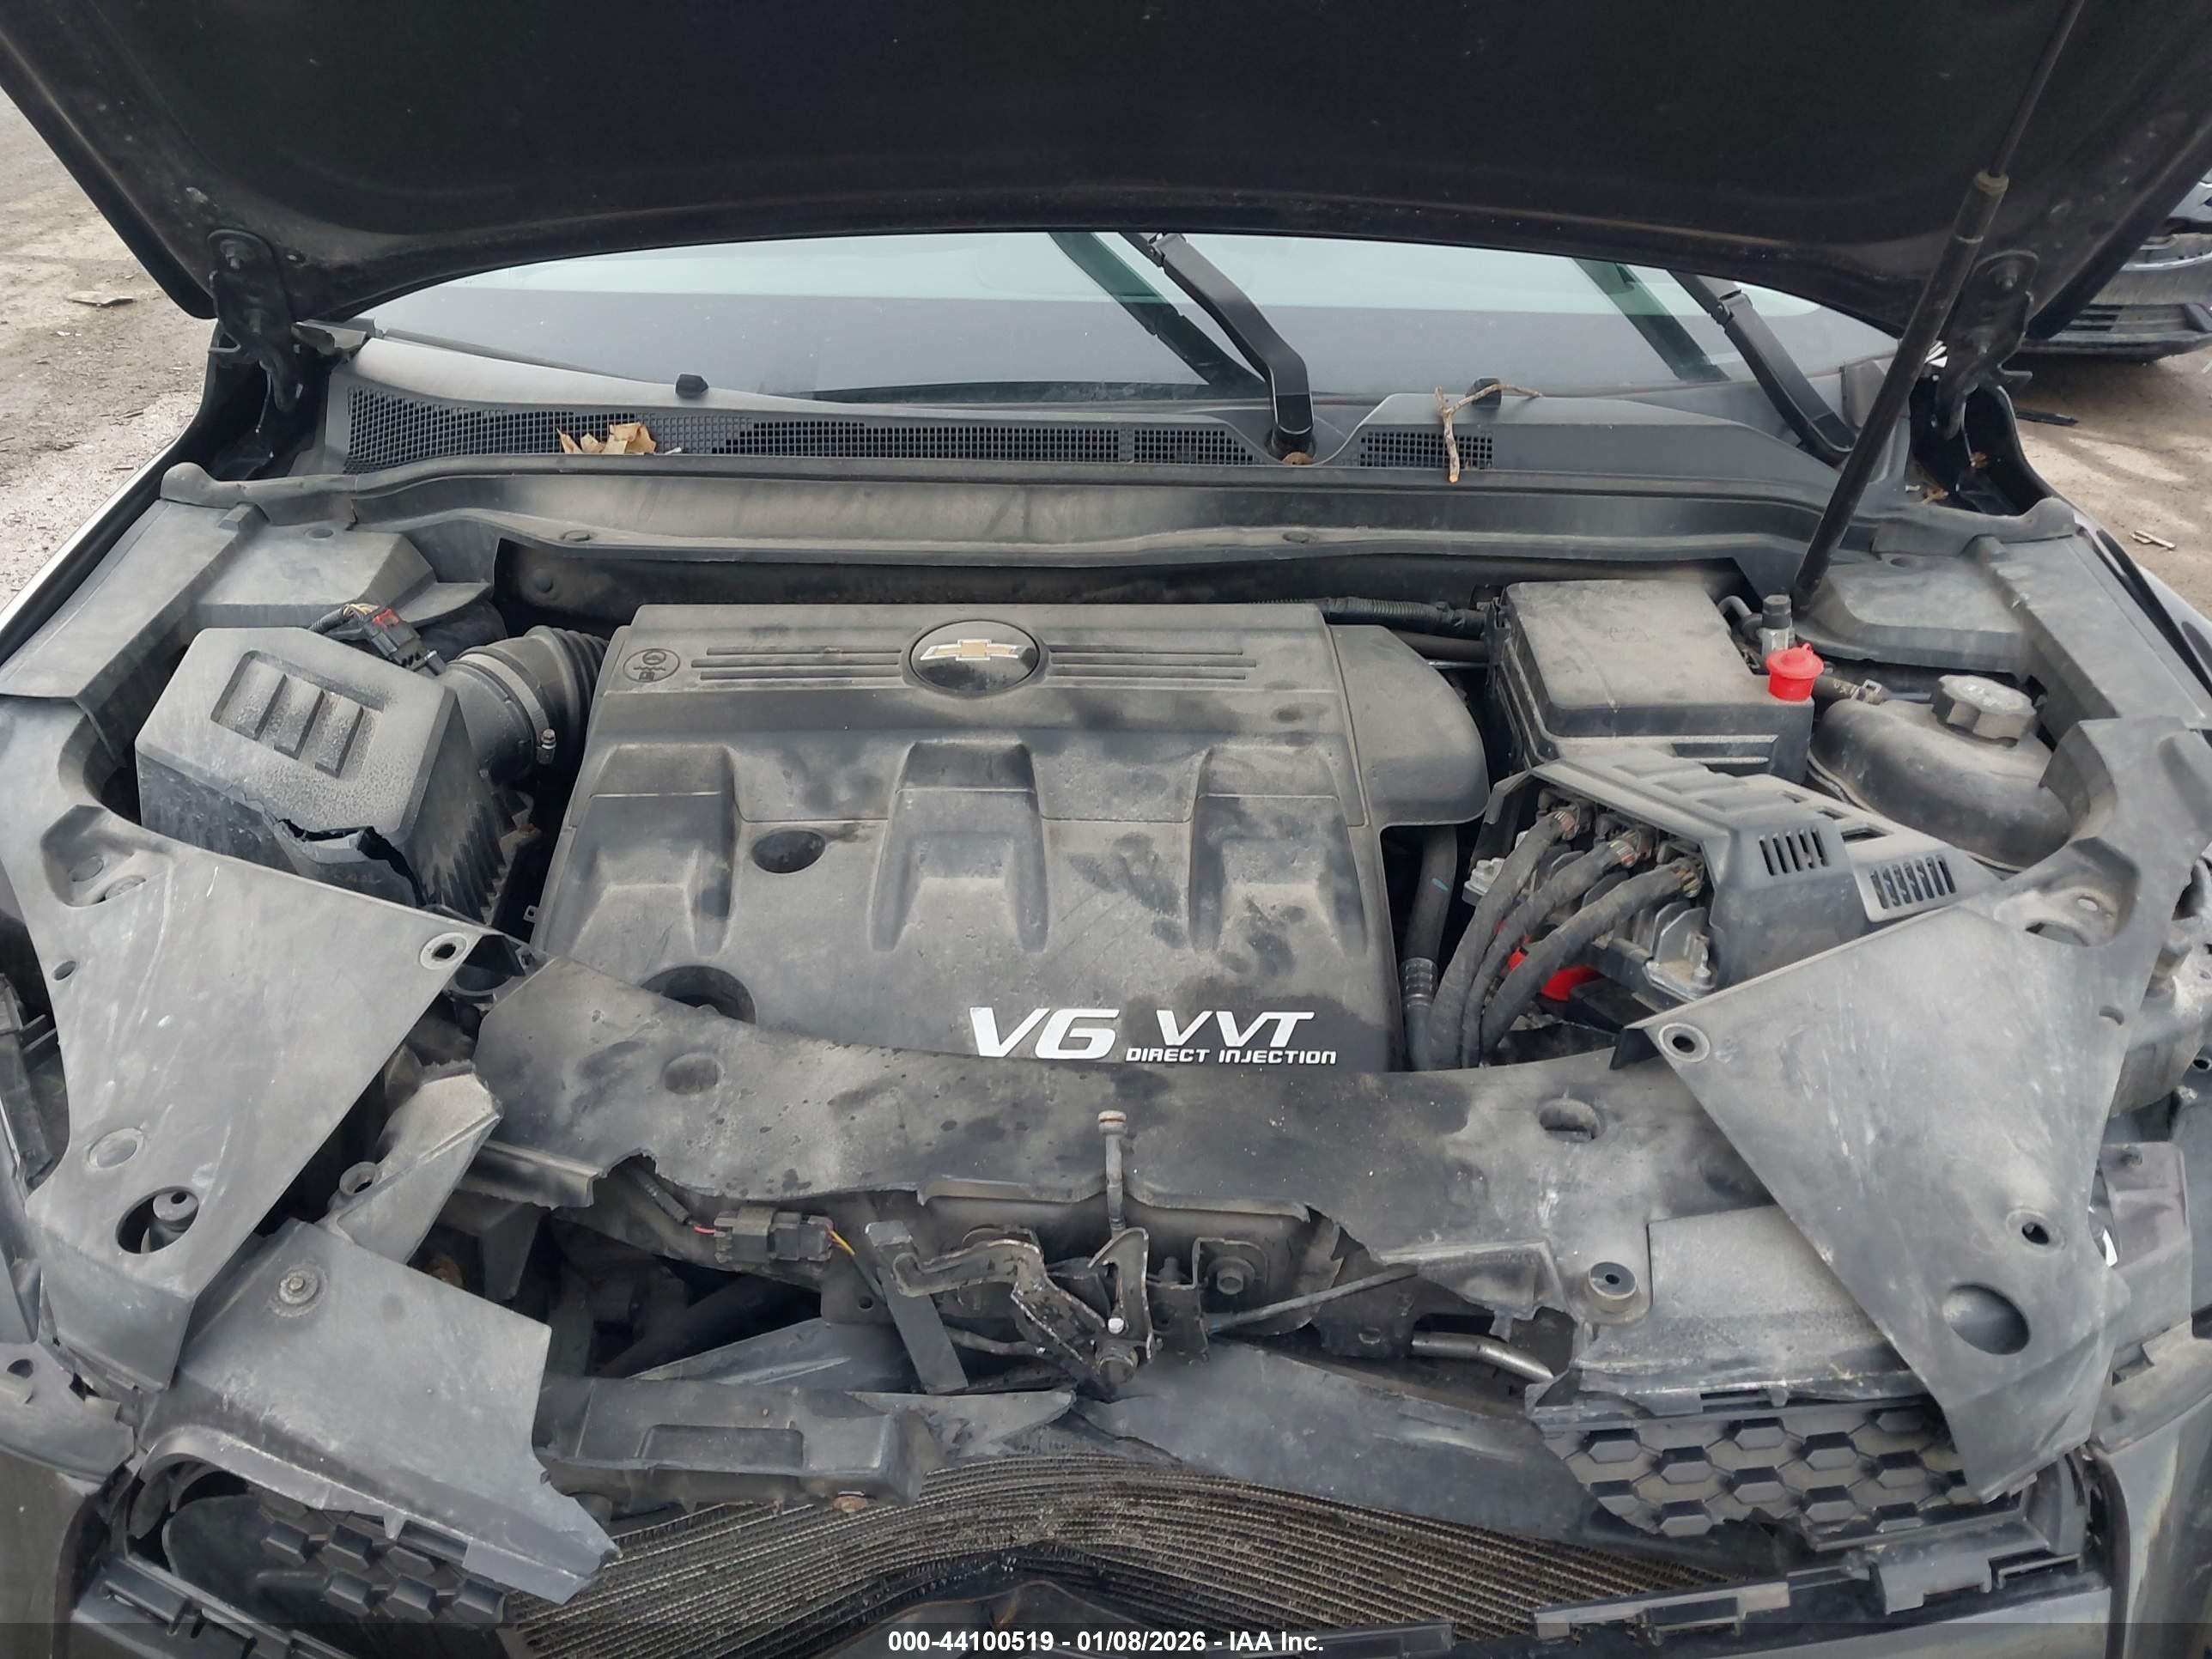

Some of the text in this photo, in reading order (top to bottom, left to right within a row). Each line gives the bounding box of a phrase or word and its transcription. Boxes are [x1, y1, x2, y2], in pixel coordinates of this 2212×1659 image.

[968, 1006, 1316, 1060] V6 VVT
[1125, 1047, 1338, 1065] DIRECT INJECTION
